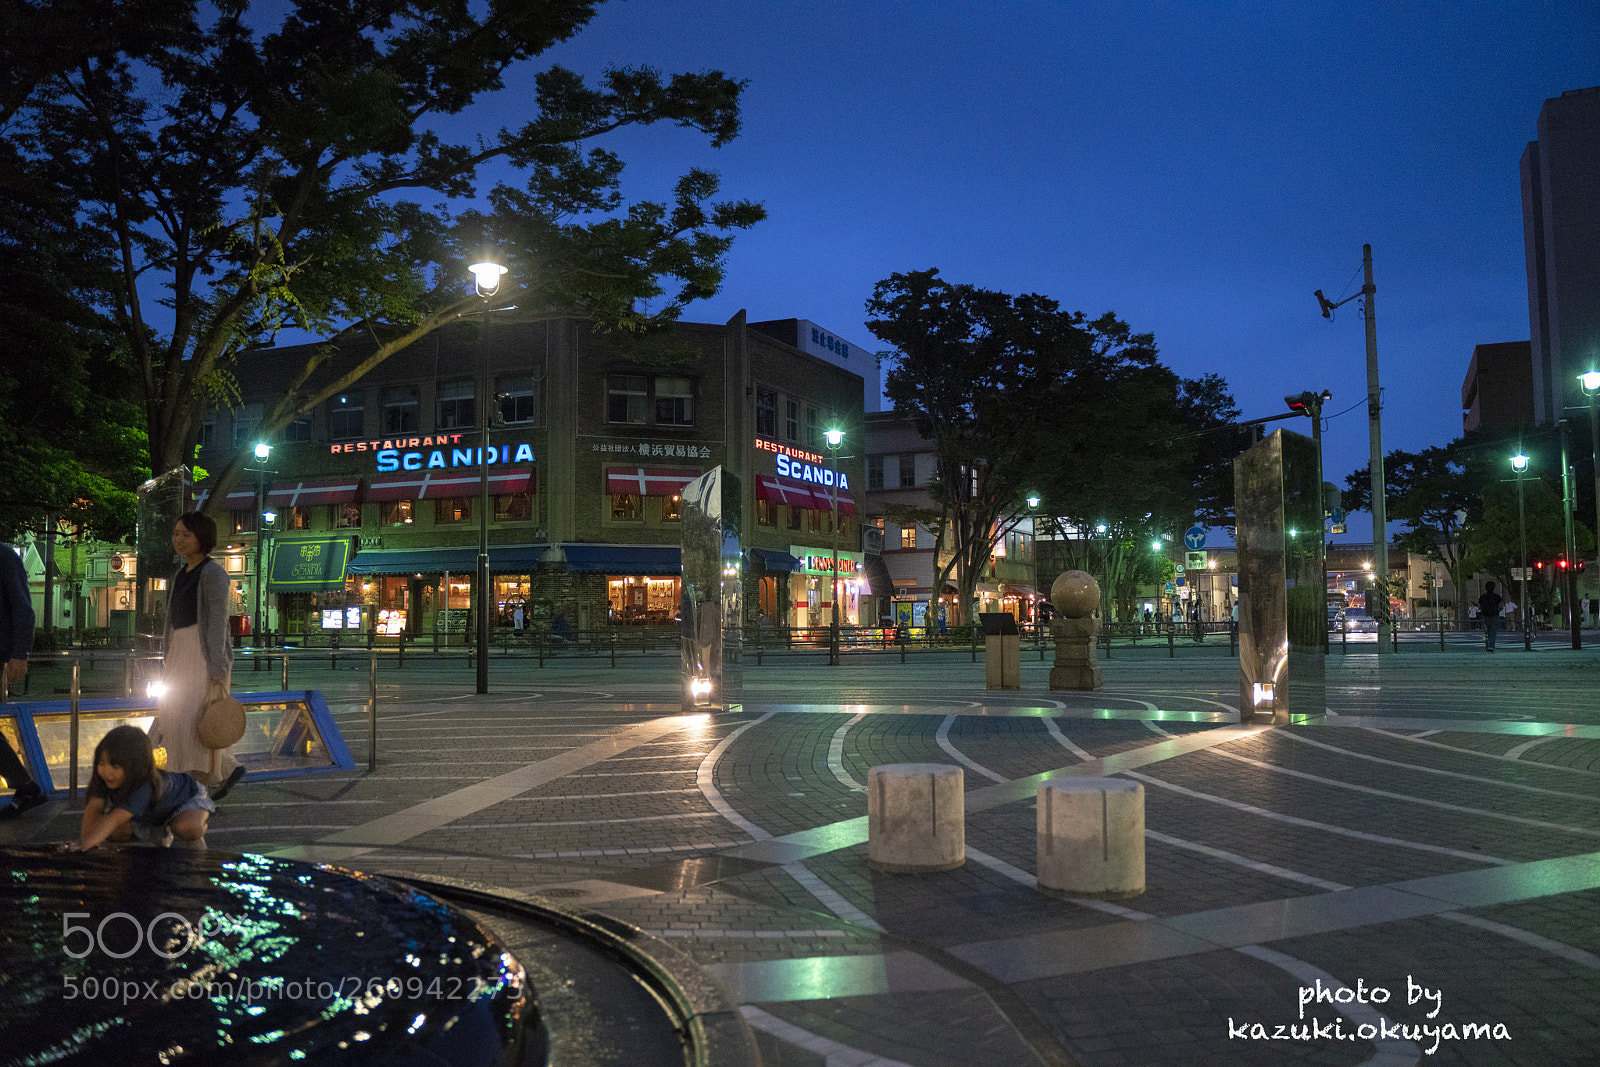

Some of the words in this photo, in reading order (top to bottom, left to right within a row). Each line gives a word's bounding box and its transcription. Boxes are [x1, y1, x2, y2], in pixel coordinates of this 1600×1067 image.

[330, 434, 462, 454] RESTAURANT
[639, 443, 711, 459] 横浜貿易協会
[755, 438, 824, 464] RESTAURANT
[376, 443, 534, 472] SCANDIA
[776, 453, 849, 490] SCANDIA
